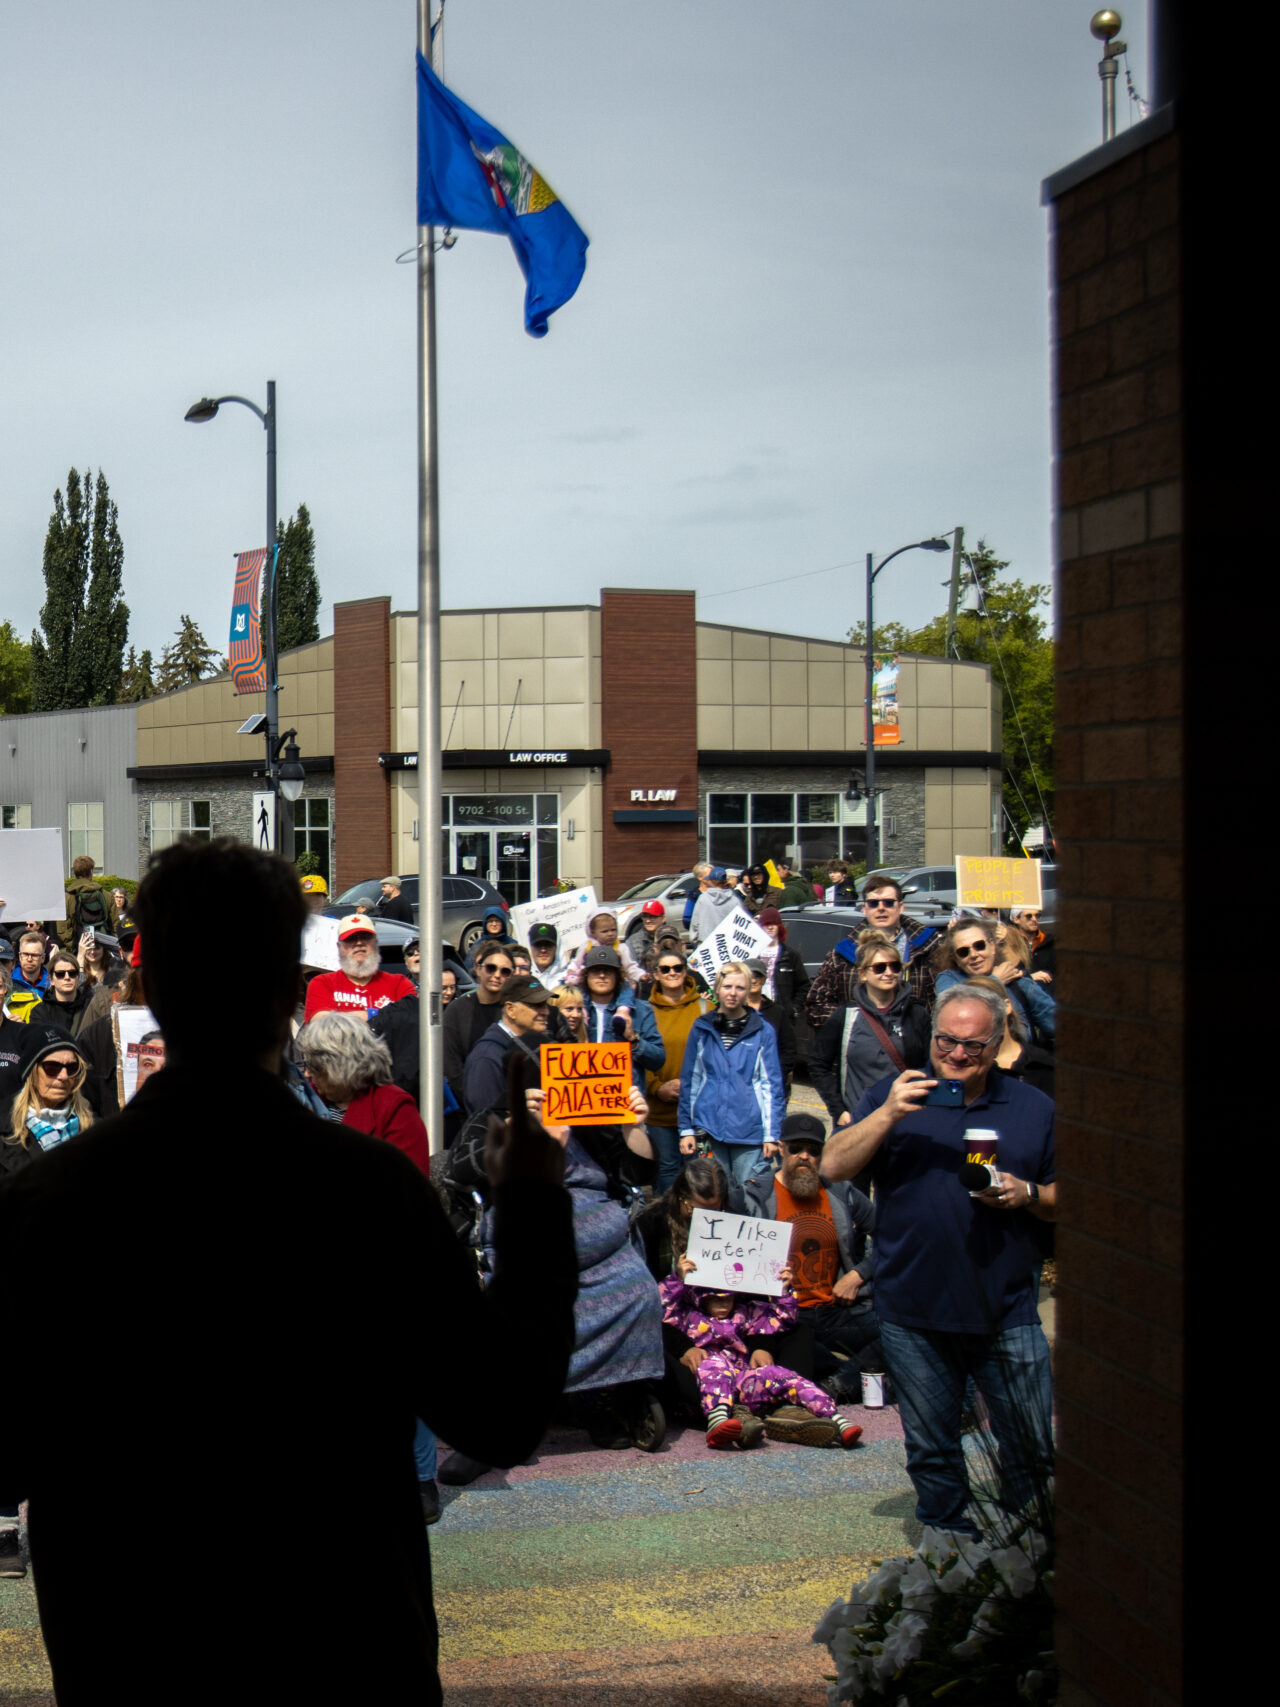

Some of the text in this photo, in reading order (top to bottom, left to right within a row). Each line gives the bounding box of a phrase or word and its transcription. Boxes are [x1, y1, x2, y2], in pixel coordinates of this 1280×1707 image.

[509, 753, 568, 763] LAW OFFICE
[630, 789, 677, 801] PL LAW
[458, 805, 484, 815] 9702
[494, 805, 513, 815] 100
[515, 805, 530, 815] St.
[963, 858, 1024, 874] PEOPLE
[977, 874, 1011, 886] OVER
[963, 889, 1024, 903] PROFITS
[733, 914, 752, 930] NOT
[732, 929, 757, 948] WHAT
[715, 933, 731, 966] ANCEST
[732, 945, 750, 960] OUR
[127, 1044, 163, 1055] EXPRO
[547, 1048, 628, 1078] FUCK OFF
[548, 1082, 622, 1117] DATA CEN
[700, 1216, 778, 1241] I like
[701, 1242, 764, 1261] water!
